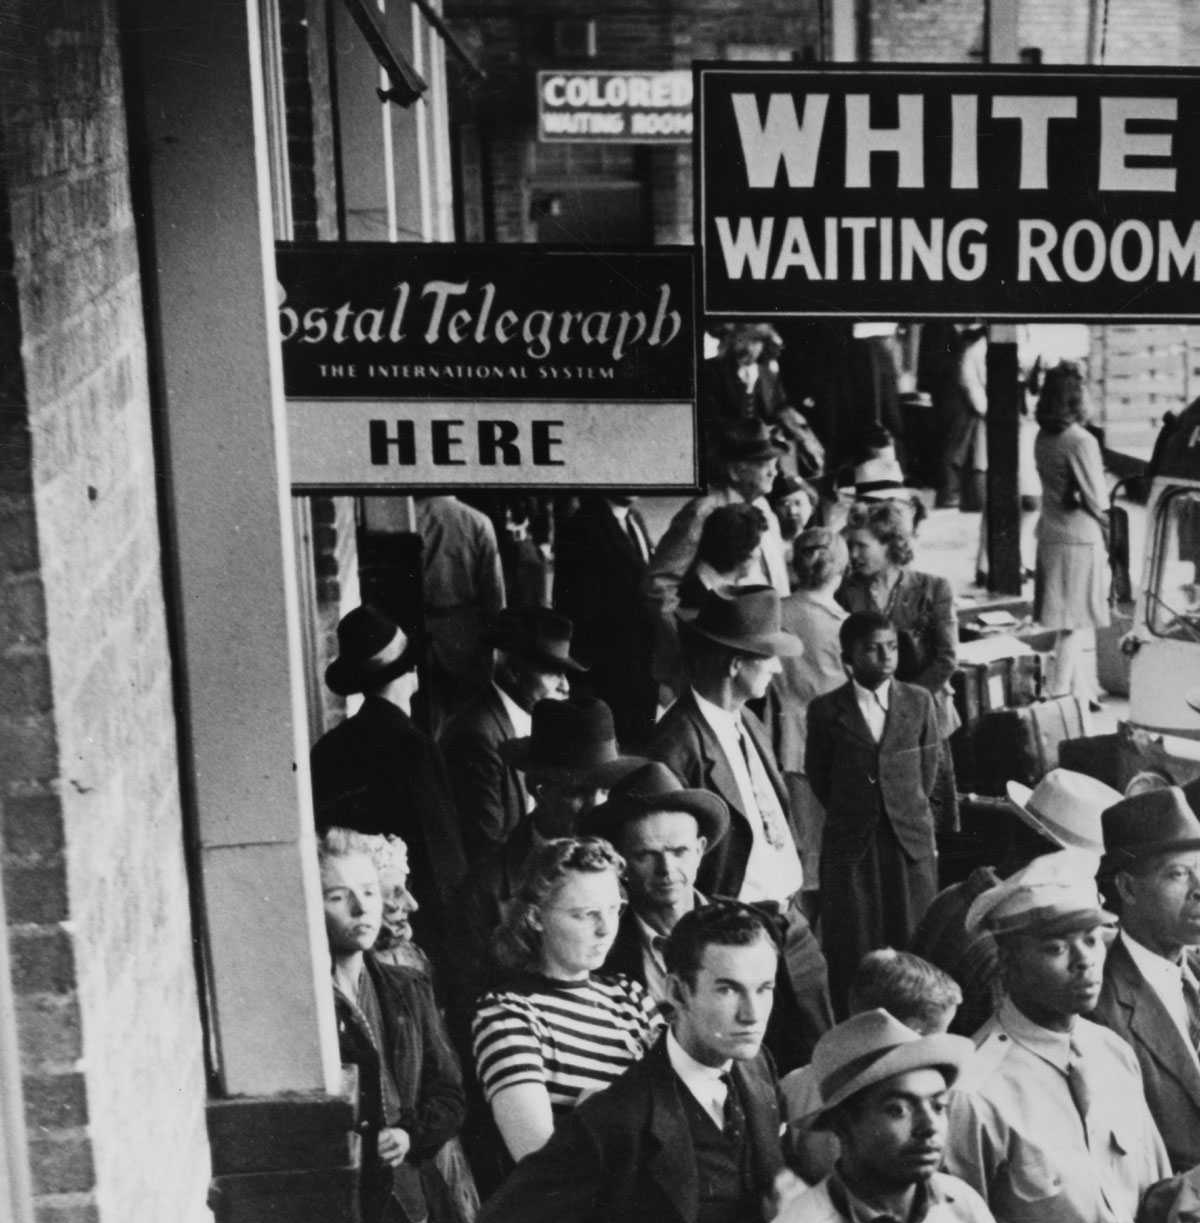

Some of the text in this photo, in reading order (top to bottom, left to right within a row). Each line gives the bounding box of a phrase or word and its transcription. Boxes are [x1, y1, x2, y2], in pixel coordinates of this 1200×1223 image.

[544, 76, 693, 107] COLORED
[542, 112, 624, 134] WAITING
[731, 93, 1178, 192] WHITE
[715, 217, 988, 281] WAITING
[278, 279, 682, 360] ostal Telegraph
[319, 364, 614, 379] THE INTERNATIONAL SYSTEM
[369, 420, 565, 466] HERE
